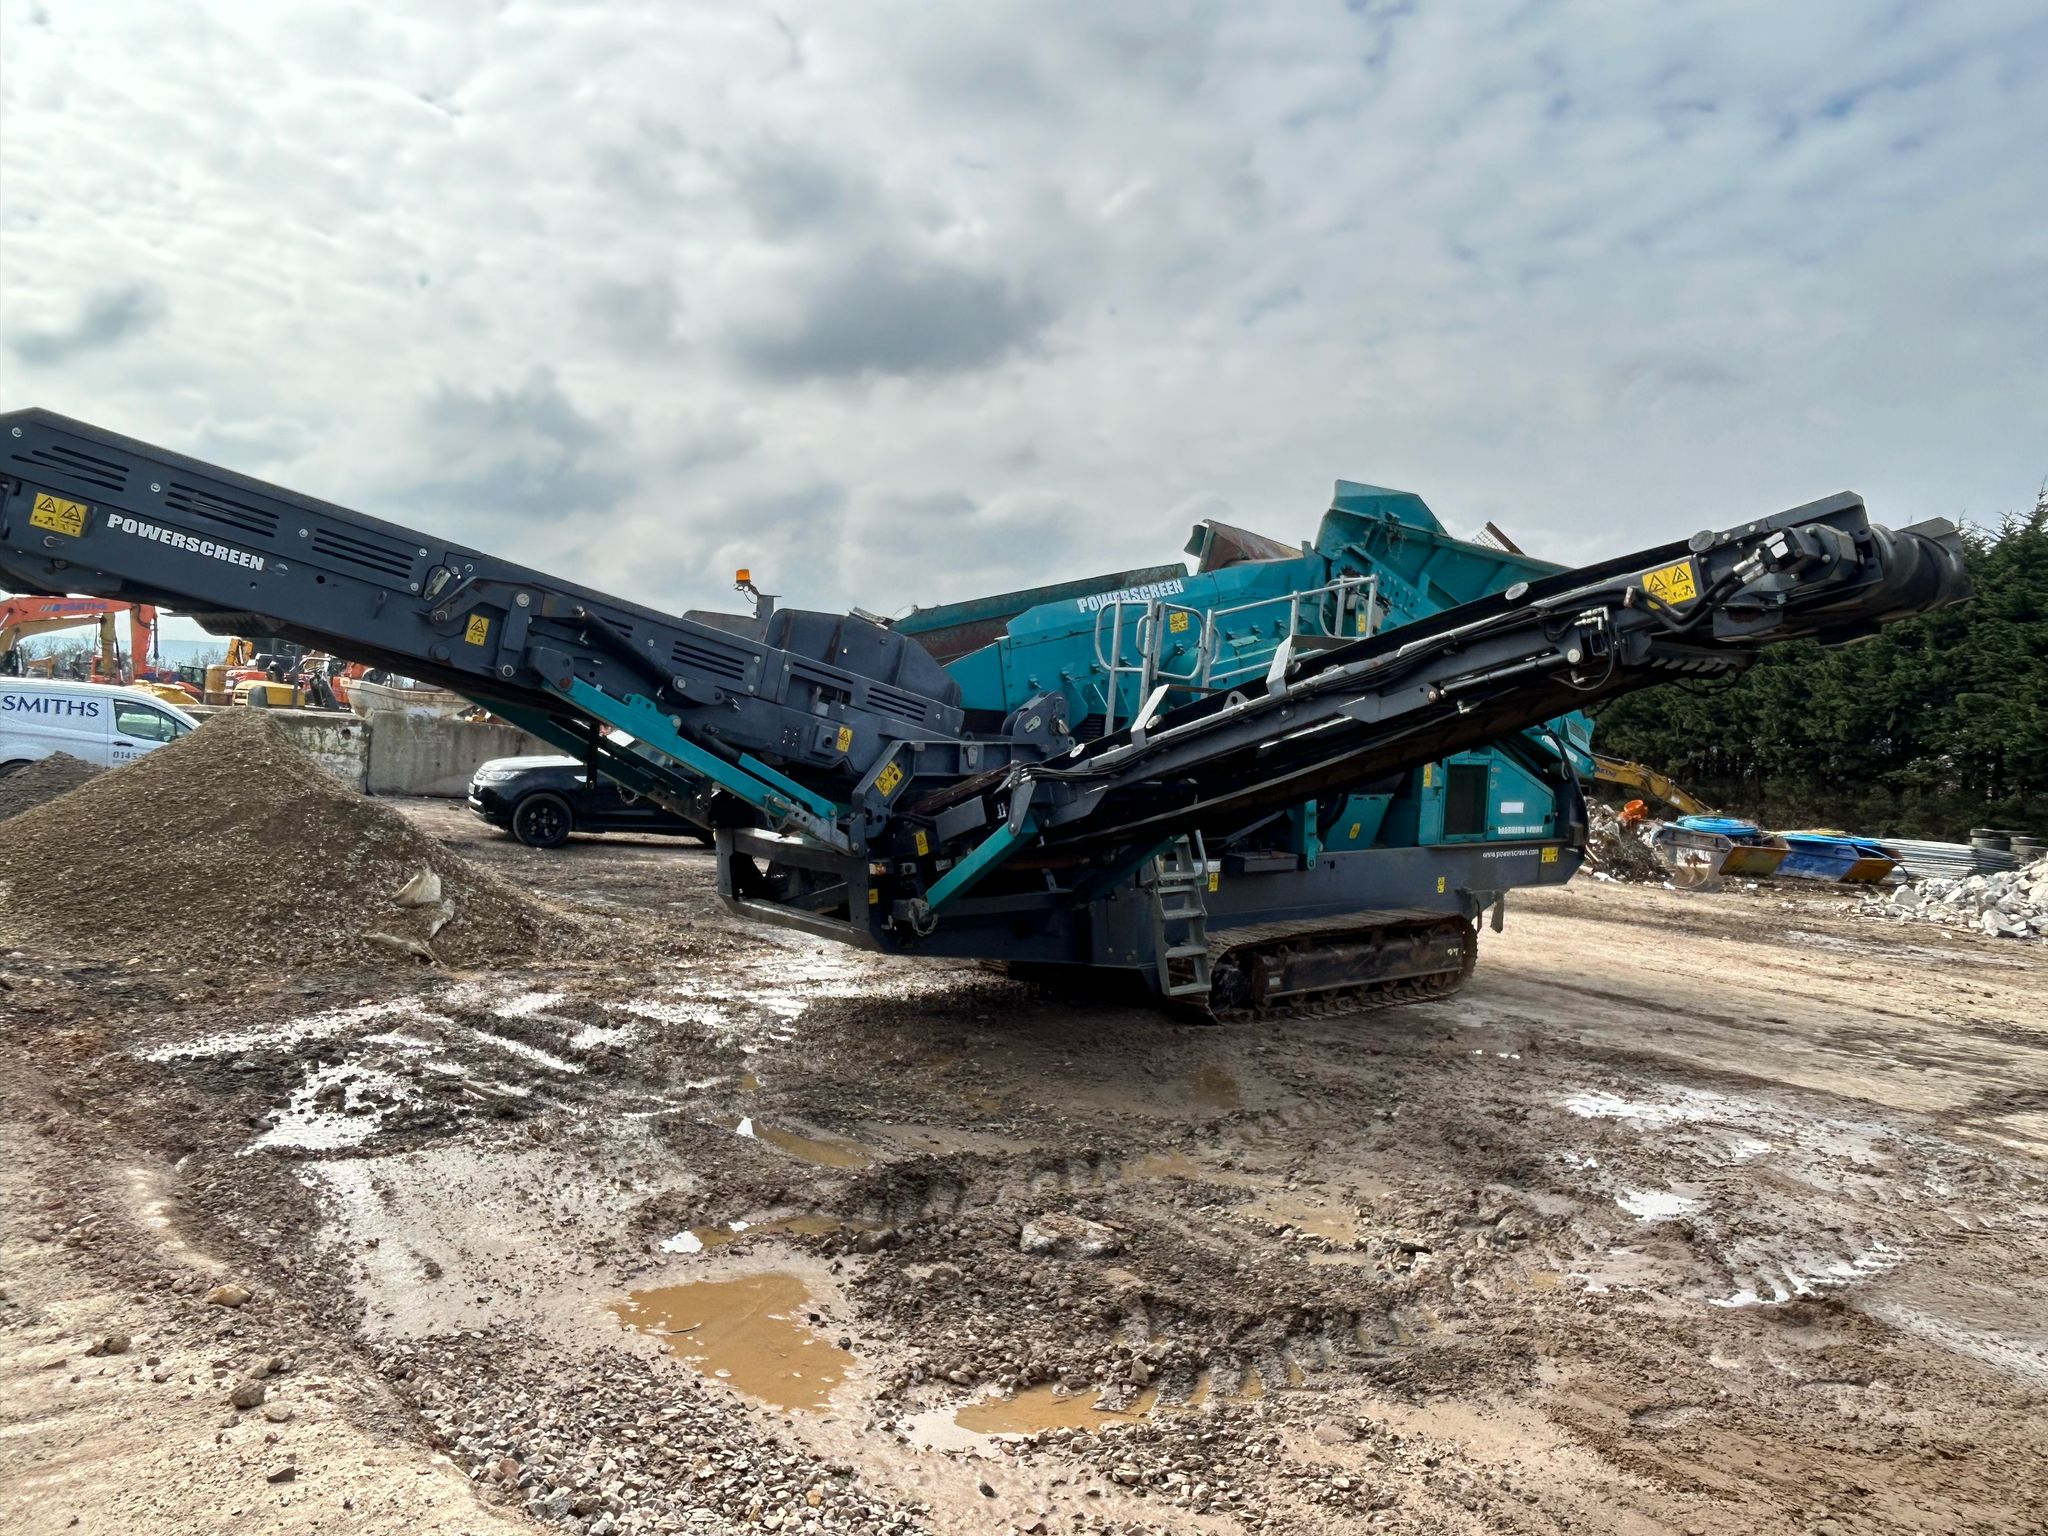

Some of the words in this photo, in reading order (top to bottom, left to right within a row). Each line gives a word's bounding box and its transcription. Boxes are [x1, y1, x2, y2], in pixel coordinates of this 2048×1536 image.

[107, 513, 264, 571] POWERSCREEN
[1077, 579, 1184, 613] POWERSCREEN
[2, 695, 99, 717] SMITHS
